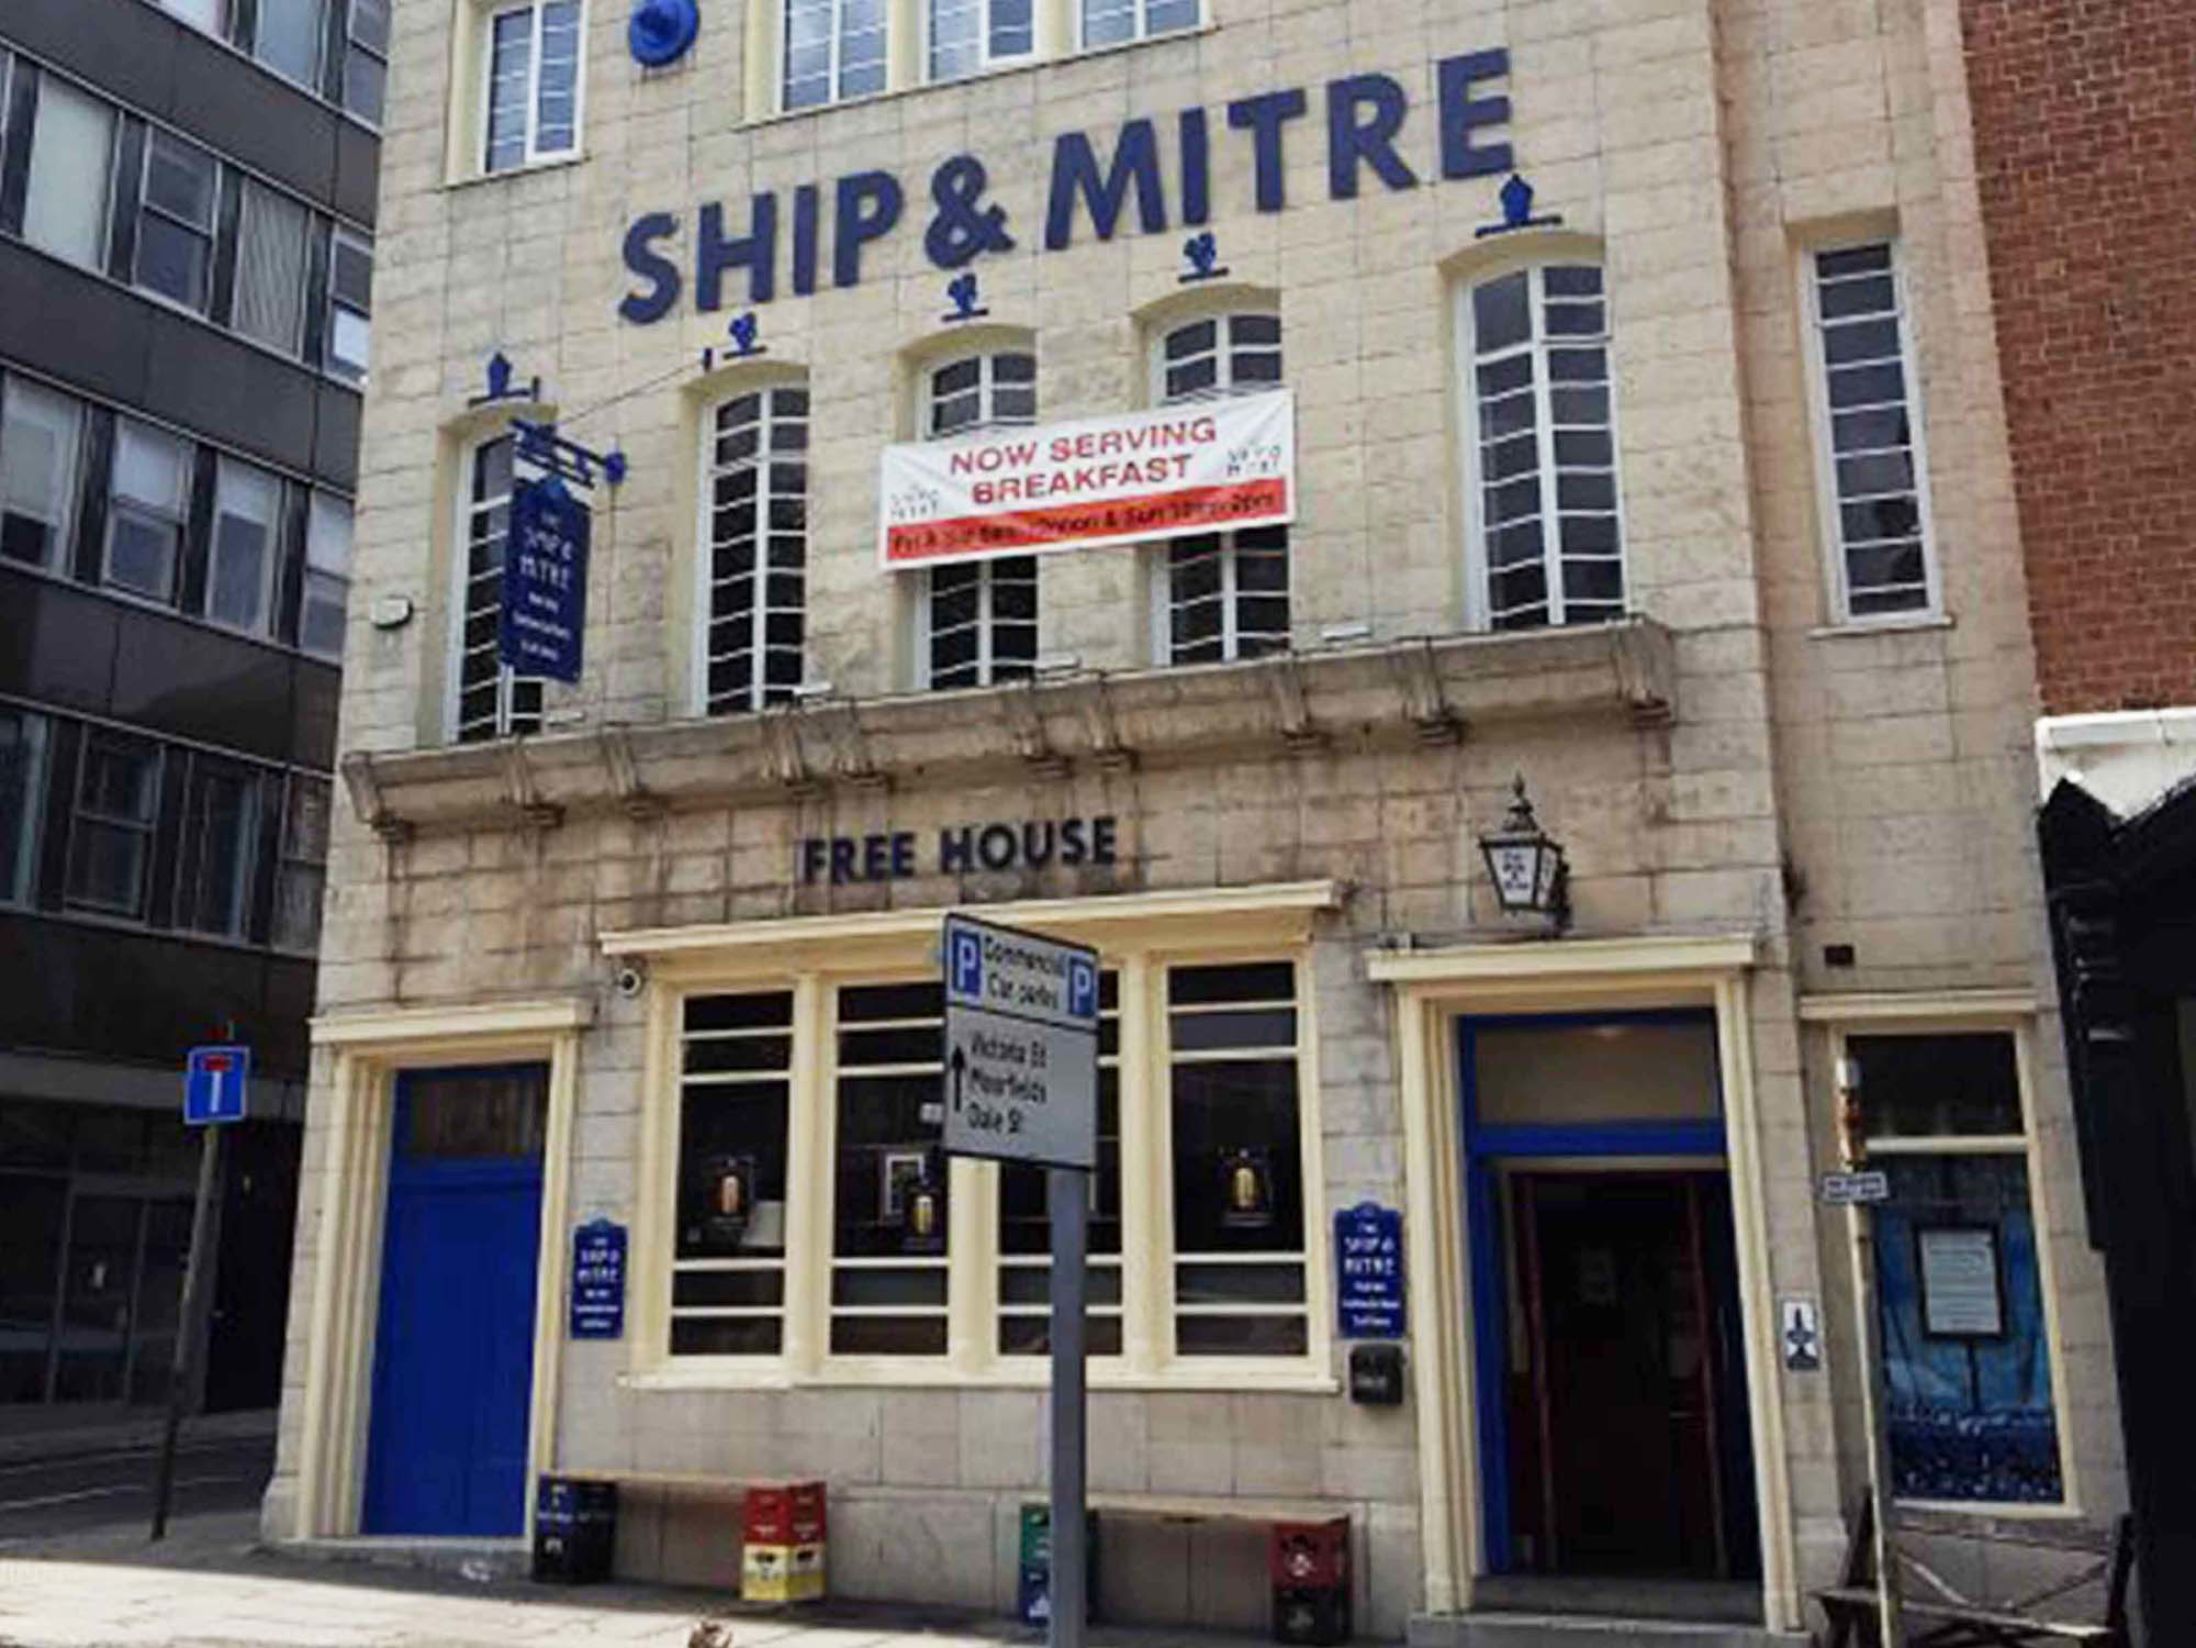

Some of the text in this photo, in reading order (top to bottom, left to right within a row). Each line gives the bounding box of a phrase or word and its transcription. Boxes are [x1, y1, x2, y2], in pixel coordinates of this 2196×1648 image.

[619, 48, 1513, 324] SHIP & MITRE
[950, 417, 1217, 475] NOW SERVING
[972, 454, 1193, 504] BREAKFAST
[801, 815, 1117, 887] FREE HOUSE
[957, 937, 977, 988] P
[1073, 966, 1091, 1013] P
